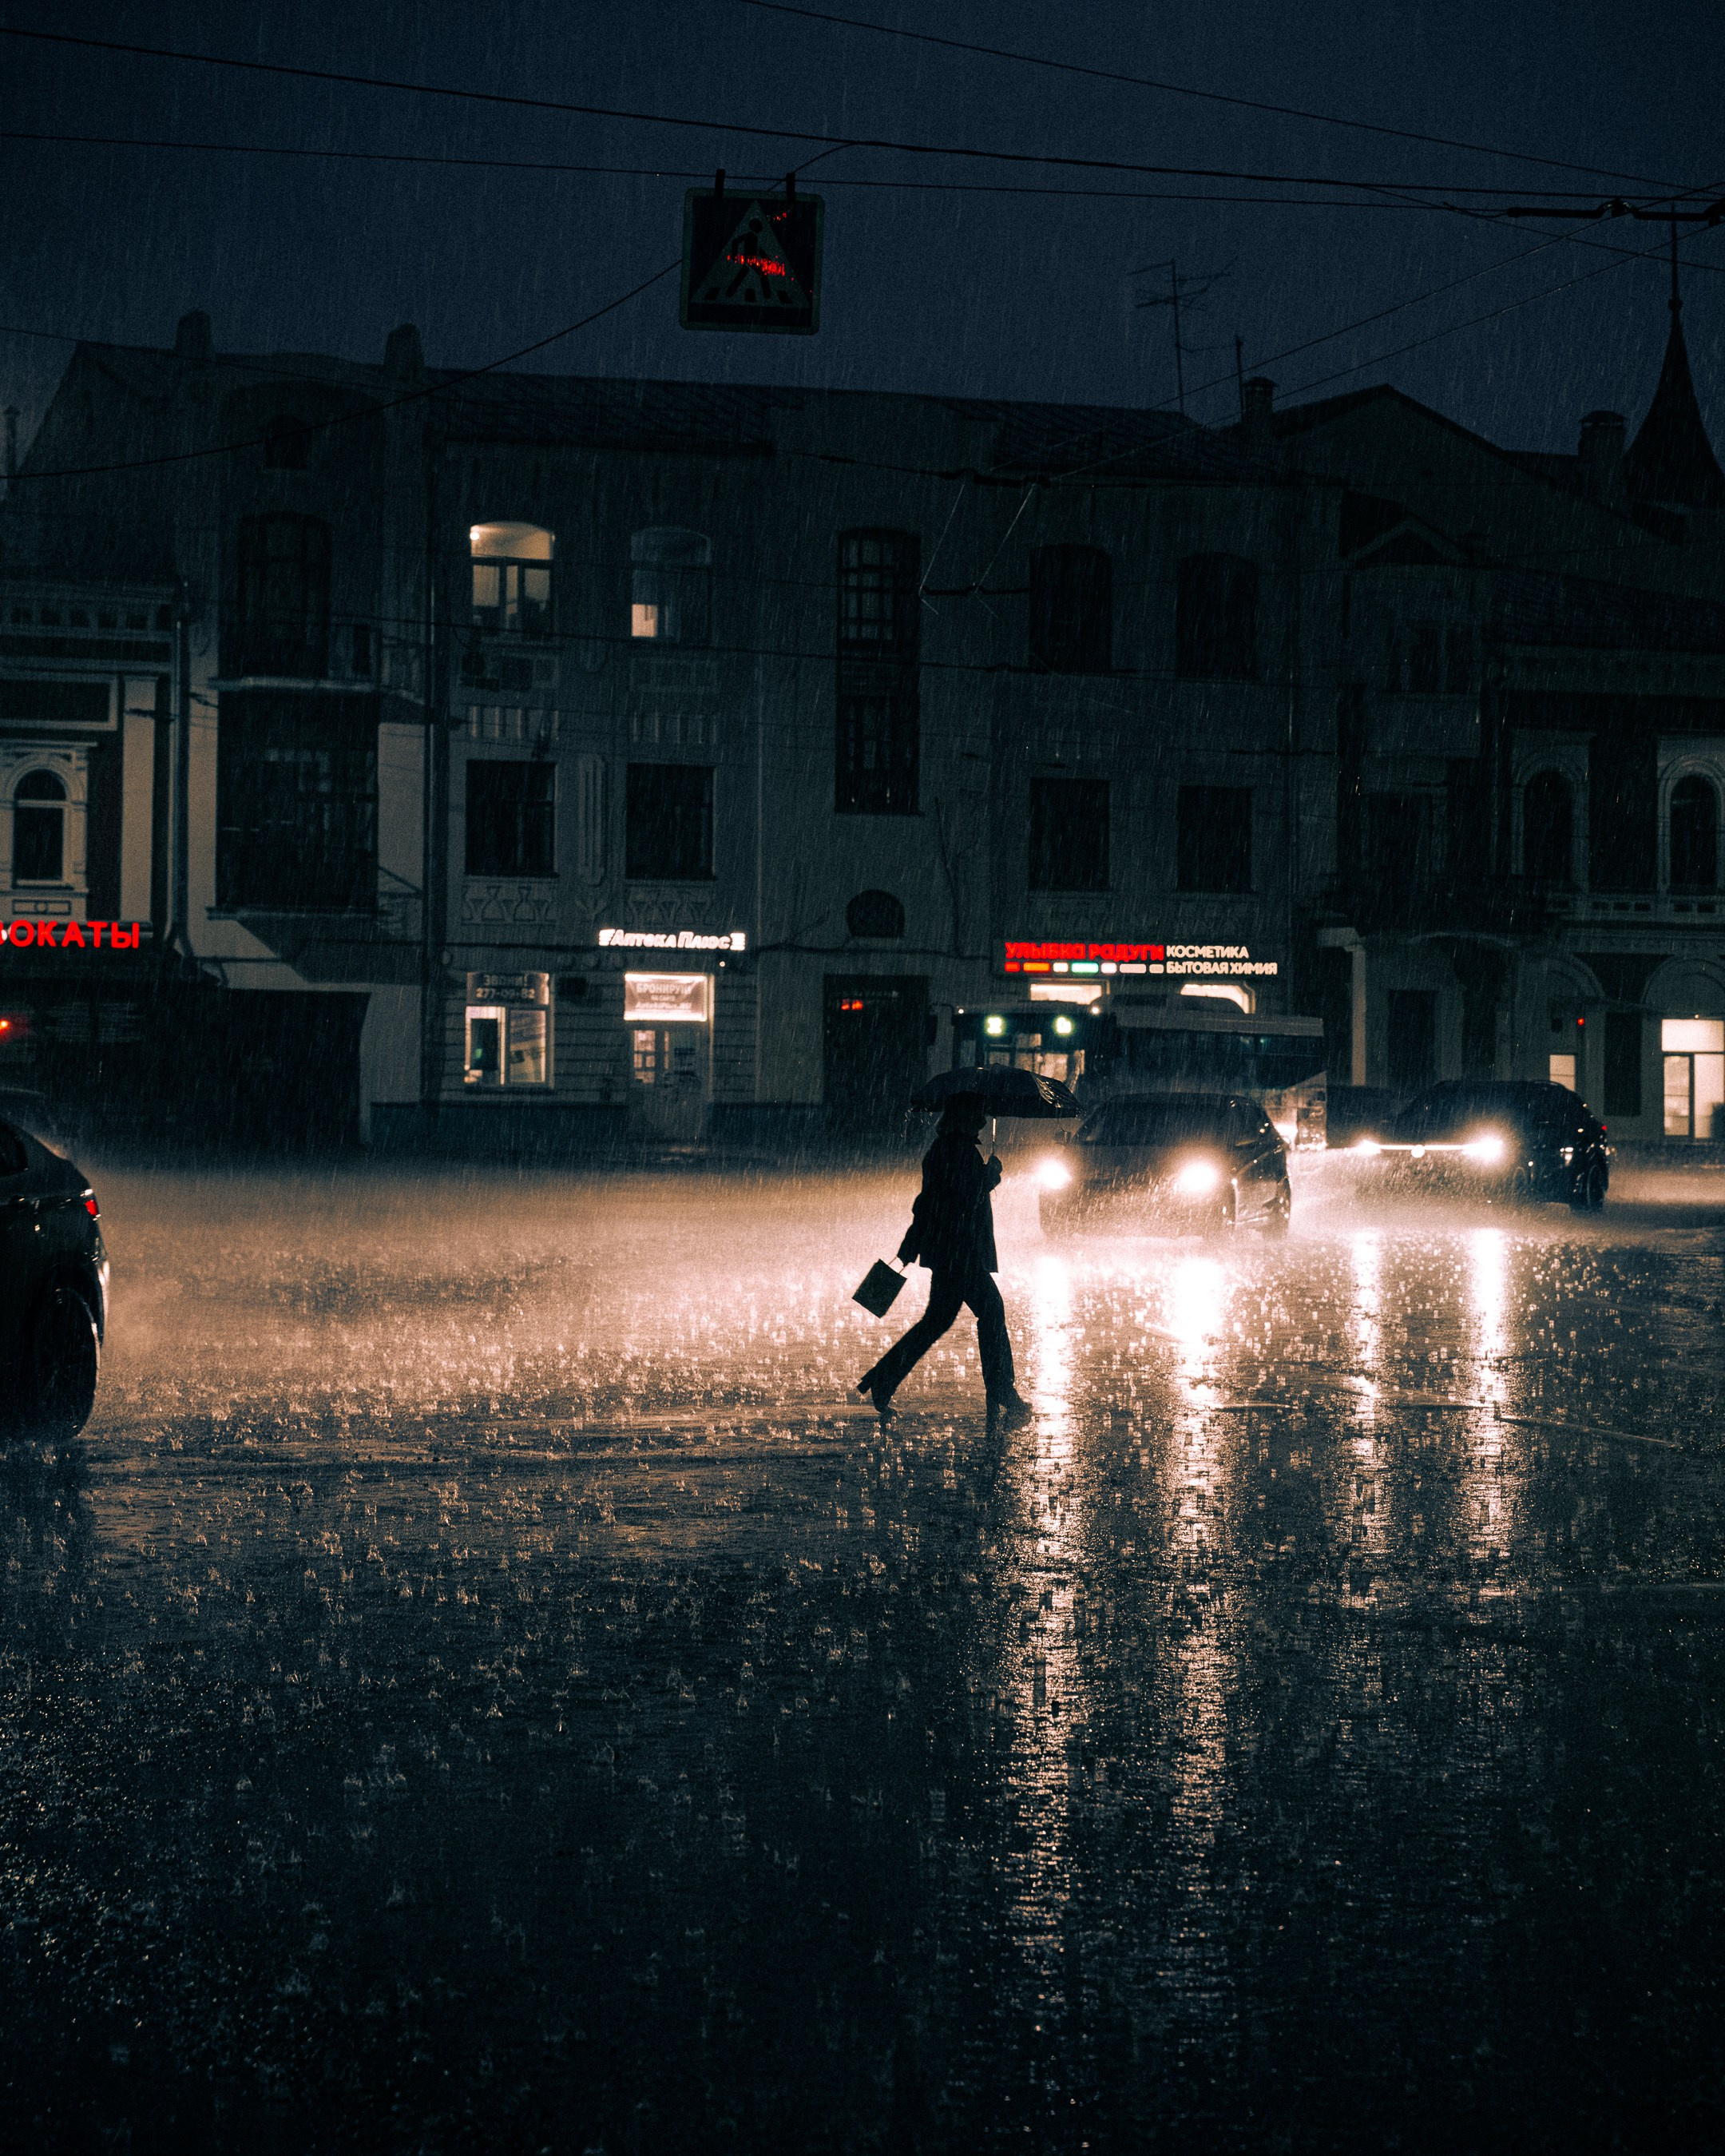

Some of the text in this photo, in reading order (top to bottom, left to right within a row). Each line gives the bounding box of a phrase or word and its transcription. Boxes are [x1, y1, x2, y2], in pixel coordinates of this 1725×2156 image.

[0, 919, 141, 949] ОКАТЫ
[1166, 945, 1249, 959] КОСМЕТИКА
[1166, 961, 1278, 975] БЫТОВАЯ ХИМИЯ
